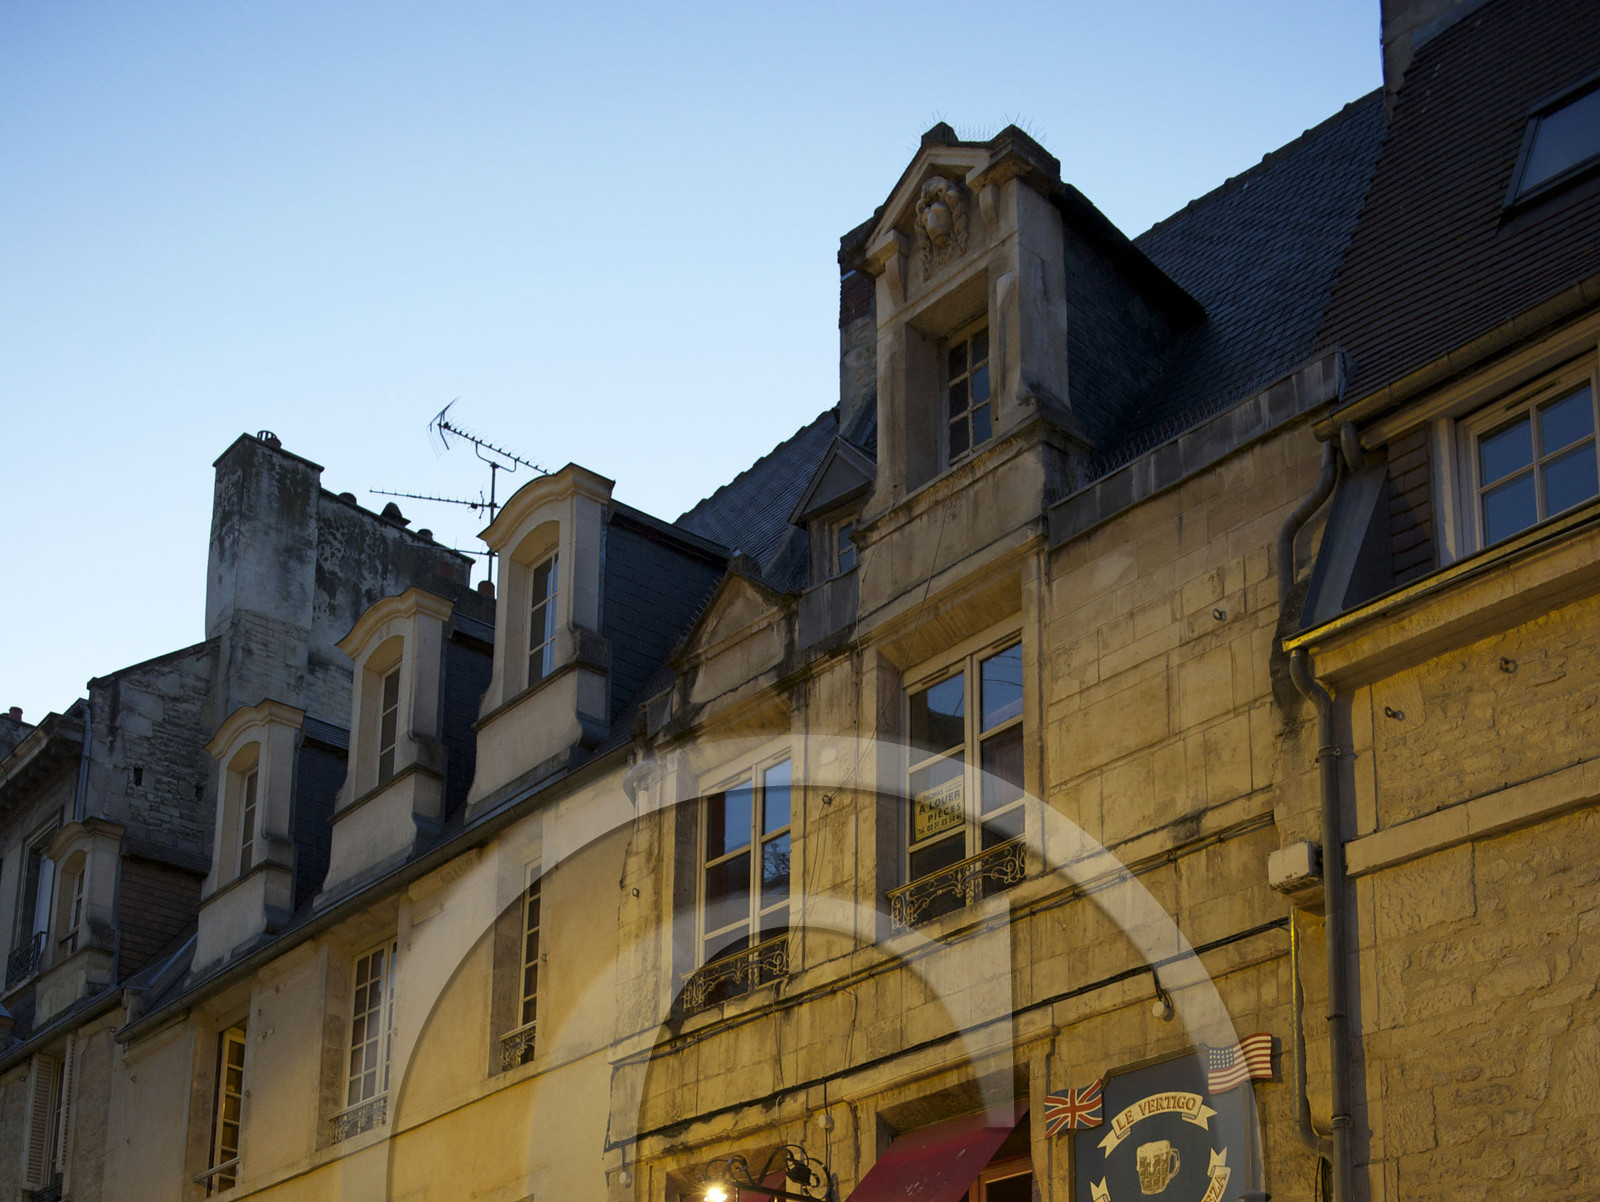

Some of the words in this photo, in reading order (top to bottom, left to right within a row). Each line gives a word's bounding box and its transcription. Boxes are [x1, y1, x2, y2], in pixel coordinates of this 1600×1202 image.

[919, 803, 926, 815] A
[929, 789, 961, 810] LOUER
[1116, 1110, 1135, 1131] LE
[1138, 1095, 1196, 1116] VERTIGO
